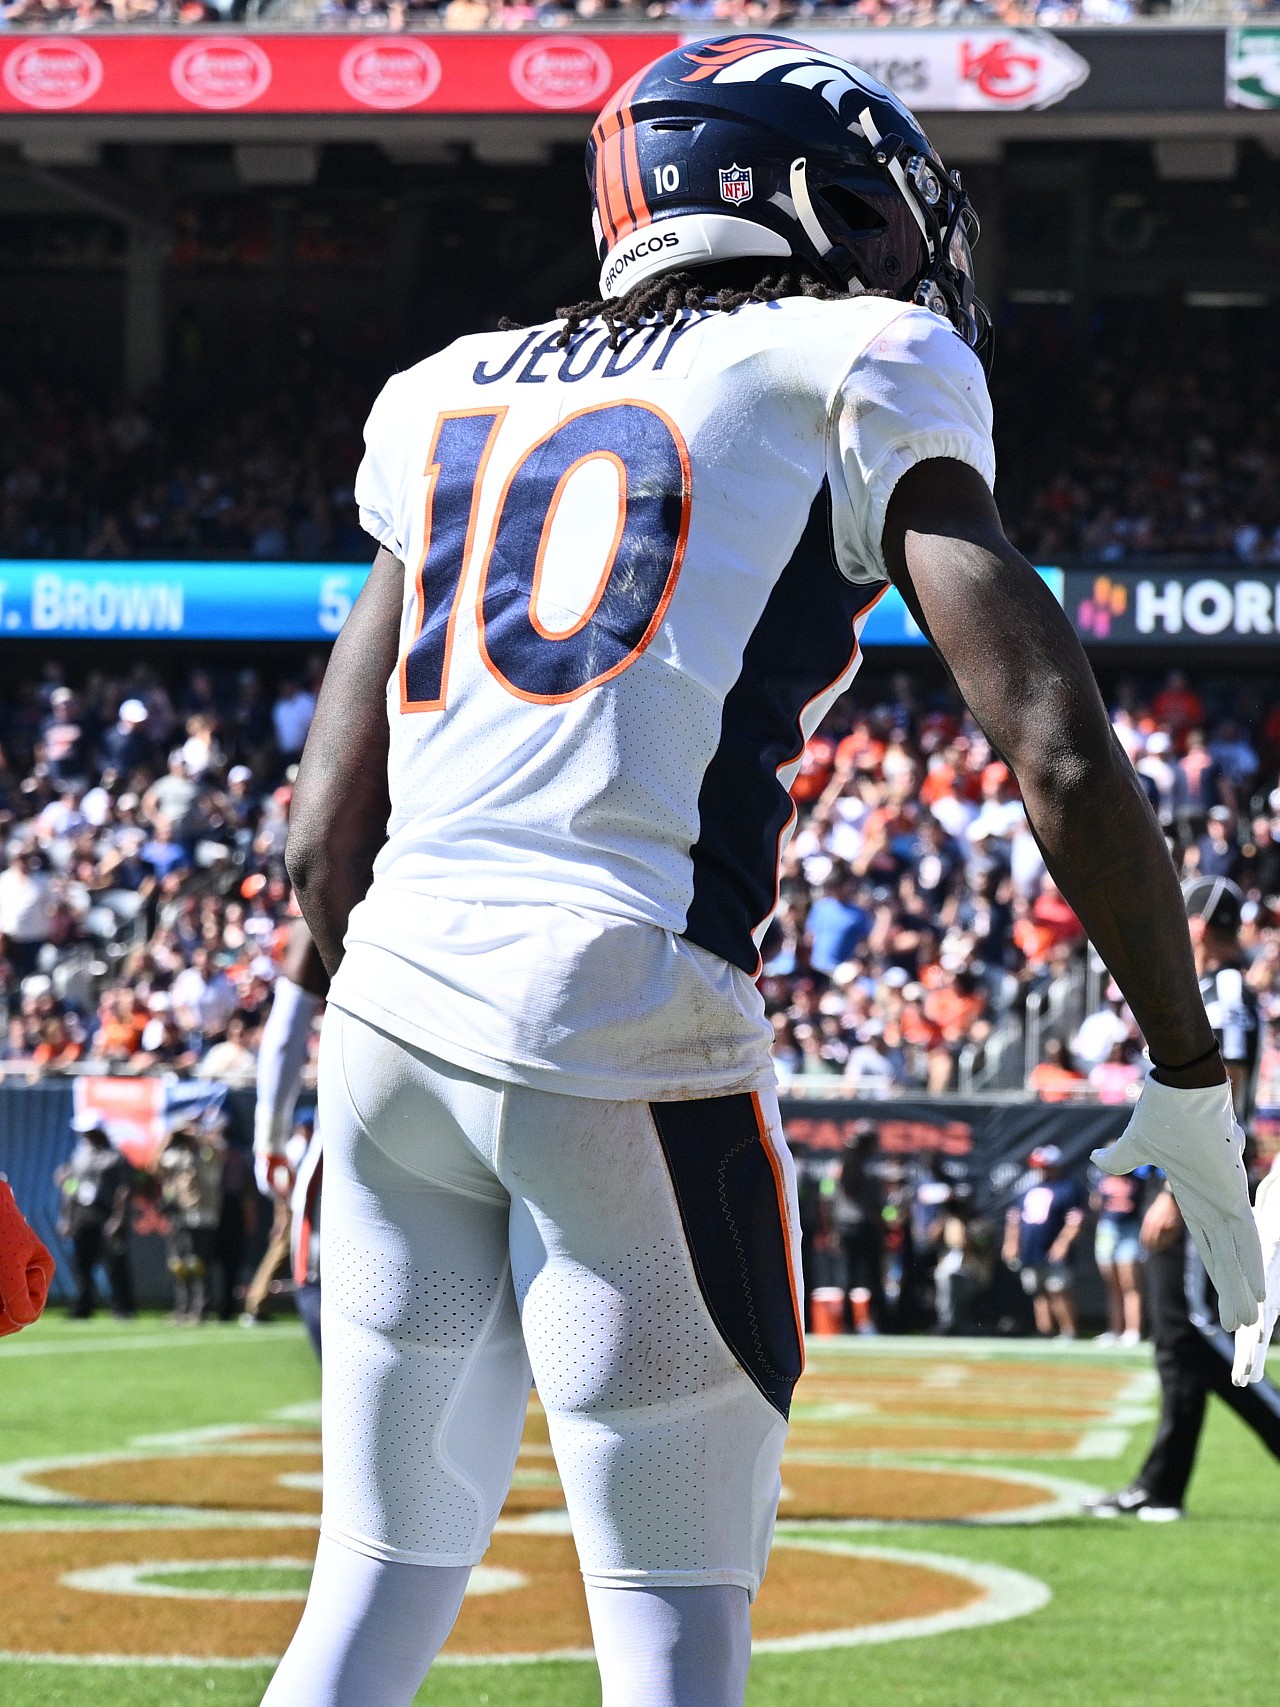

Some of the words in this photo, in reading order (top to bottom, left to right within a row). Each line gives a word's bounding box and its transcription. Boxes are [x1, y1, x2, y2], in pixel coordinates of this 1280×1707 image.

[653, 164, 680, 195] 10
[724, 181, 749, 199] NFL
[605, 231, 680, 294] BRONCOS
[472, 314, 714, 385] JEUDY
[400, 398, 693, 714] 10
